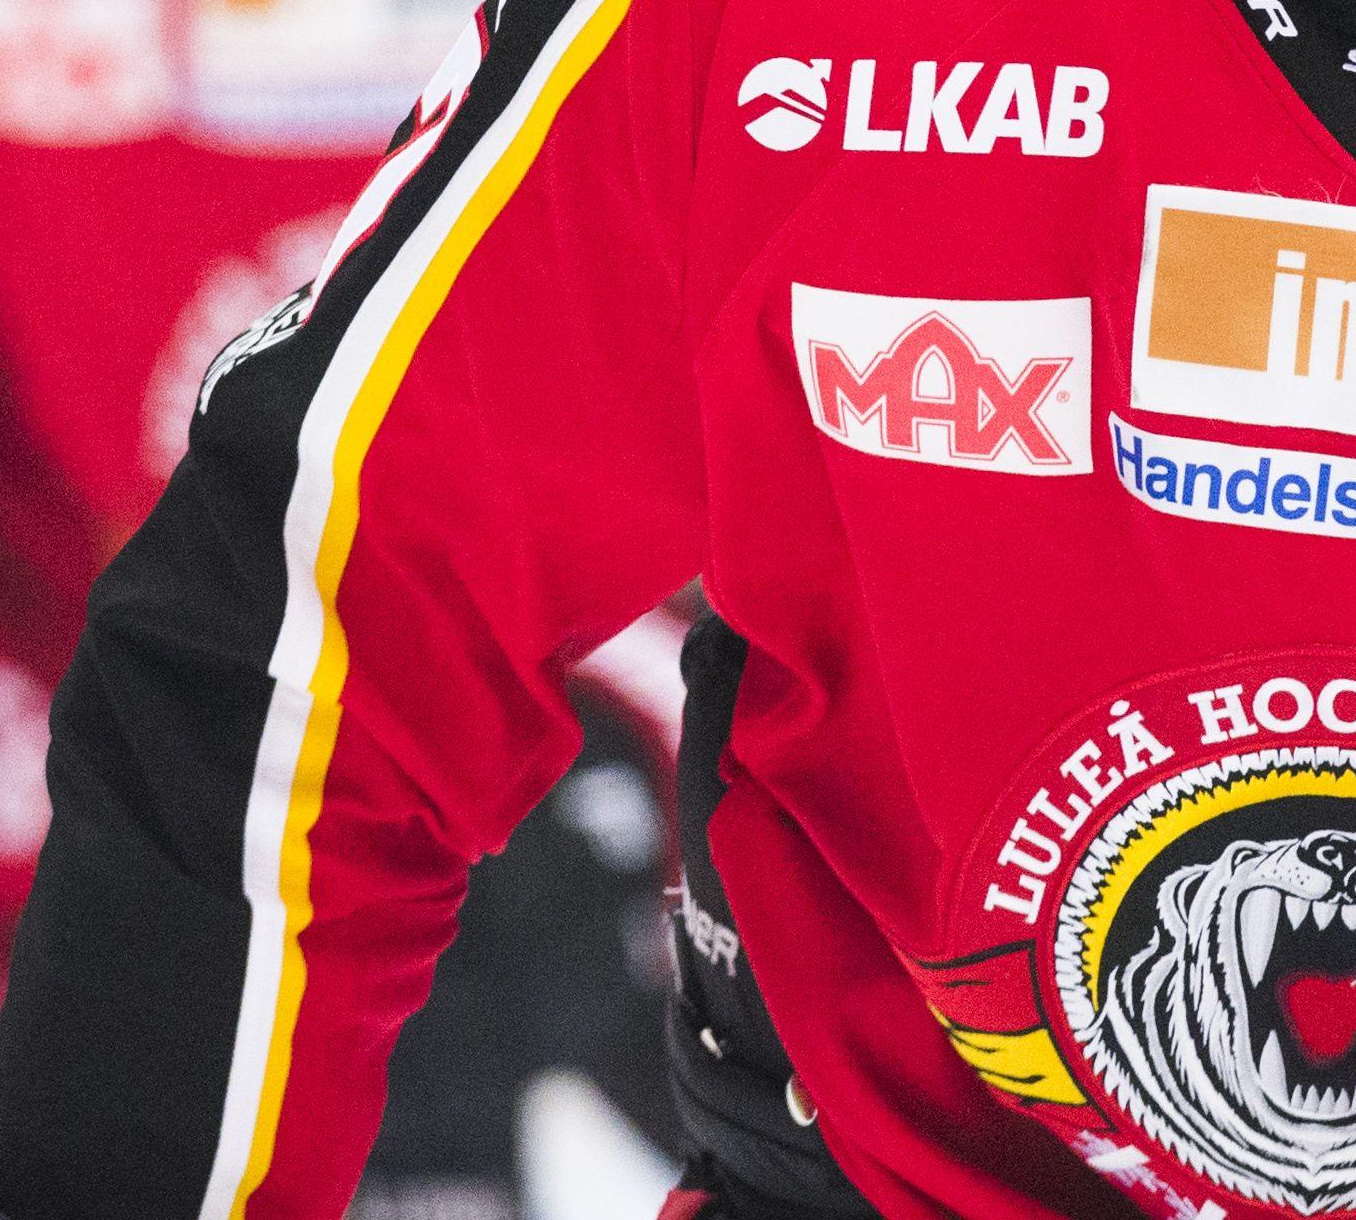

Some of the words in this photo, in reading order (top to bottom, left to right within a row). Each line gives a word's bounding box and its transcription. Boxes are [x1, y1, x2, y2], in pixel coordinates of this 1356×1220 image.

[843, 59, 1111, 158] LKAB
[808, 310, 1074, 466] MAX
[983, 699, 1174, 926] LULEÅ
